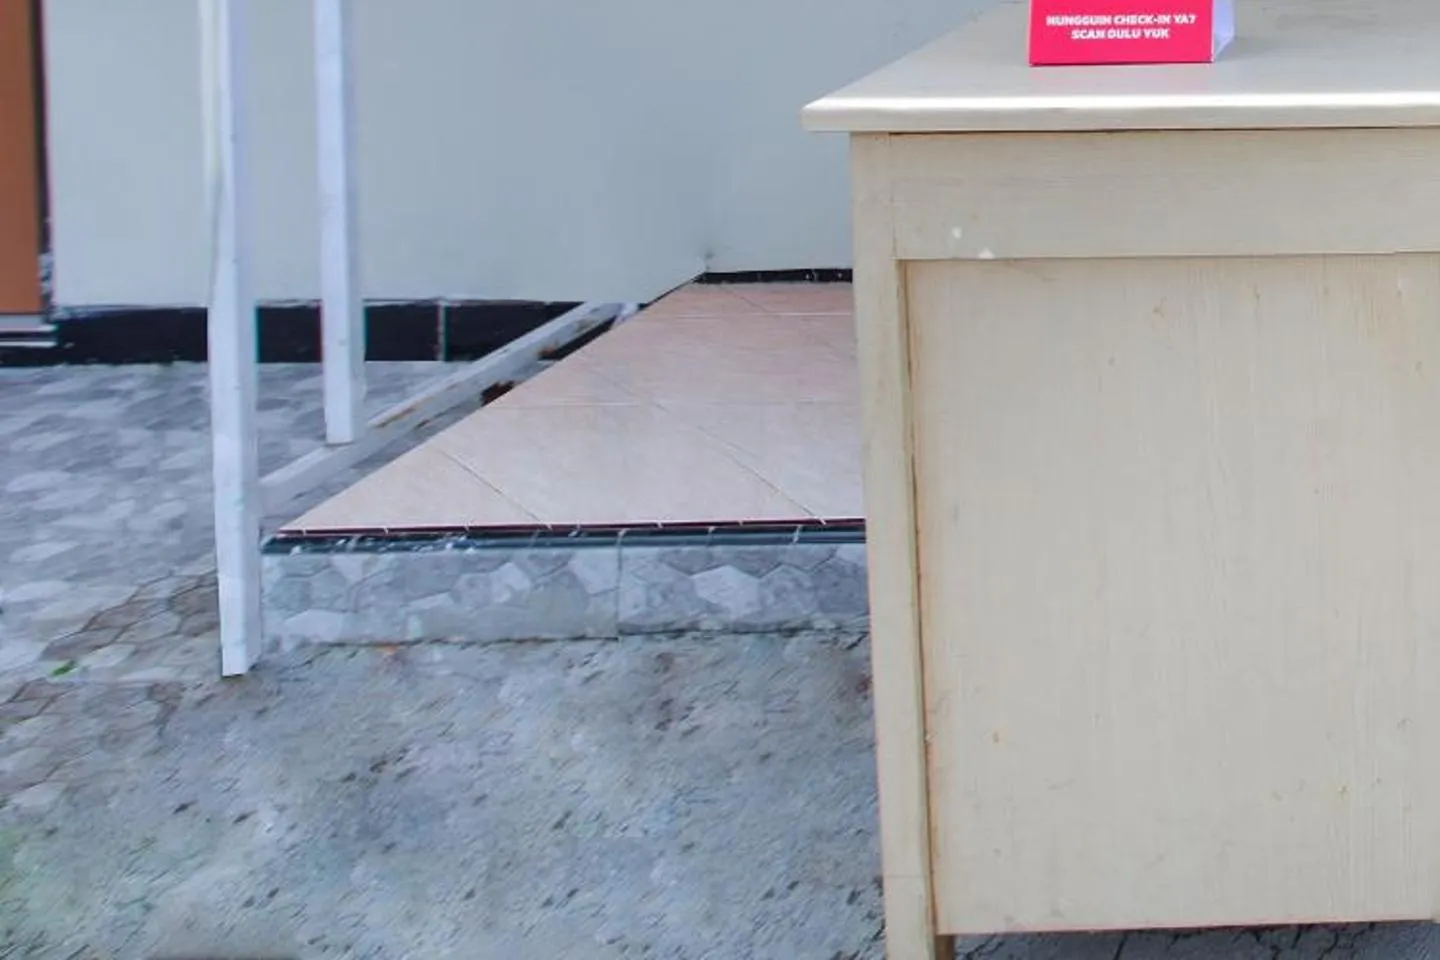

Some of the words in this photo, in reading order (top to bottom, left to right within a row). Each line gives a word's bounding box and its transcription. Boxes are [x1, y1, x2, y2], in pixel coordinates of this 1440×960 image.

[1114, 14, 1171, 25] CHECK-IN
[1071, 29, 1106, 40] SCAN
[1107, 28, 1141, 39] DULU
[1143, 28, 1170, 39] YUK
